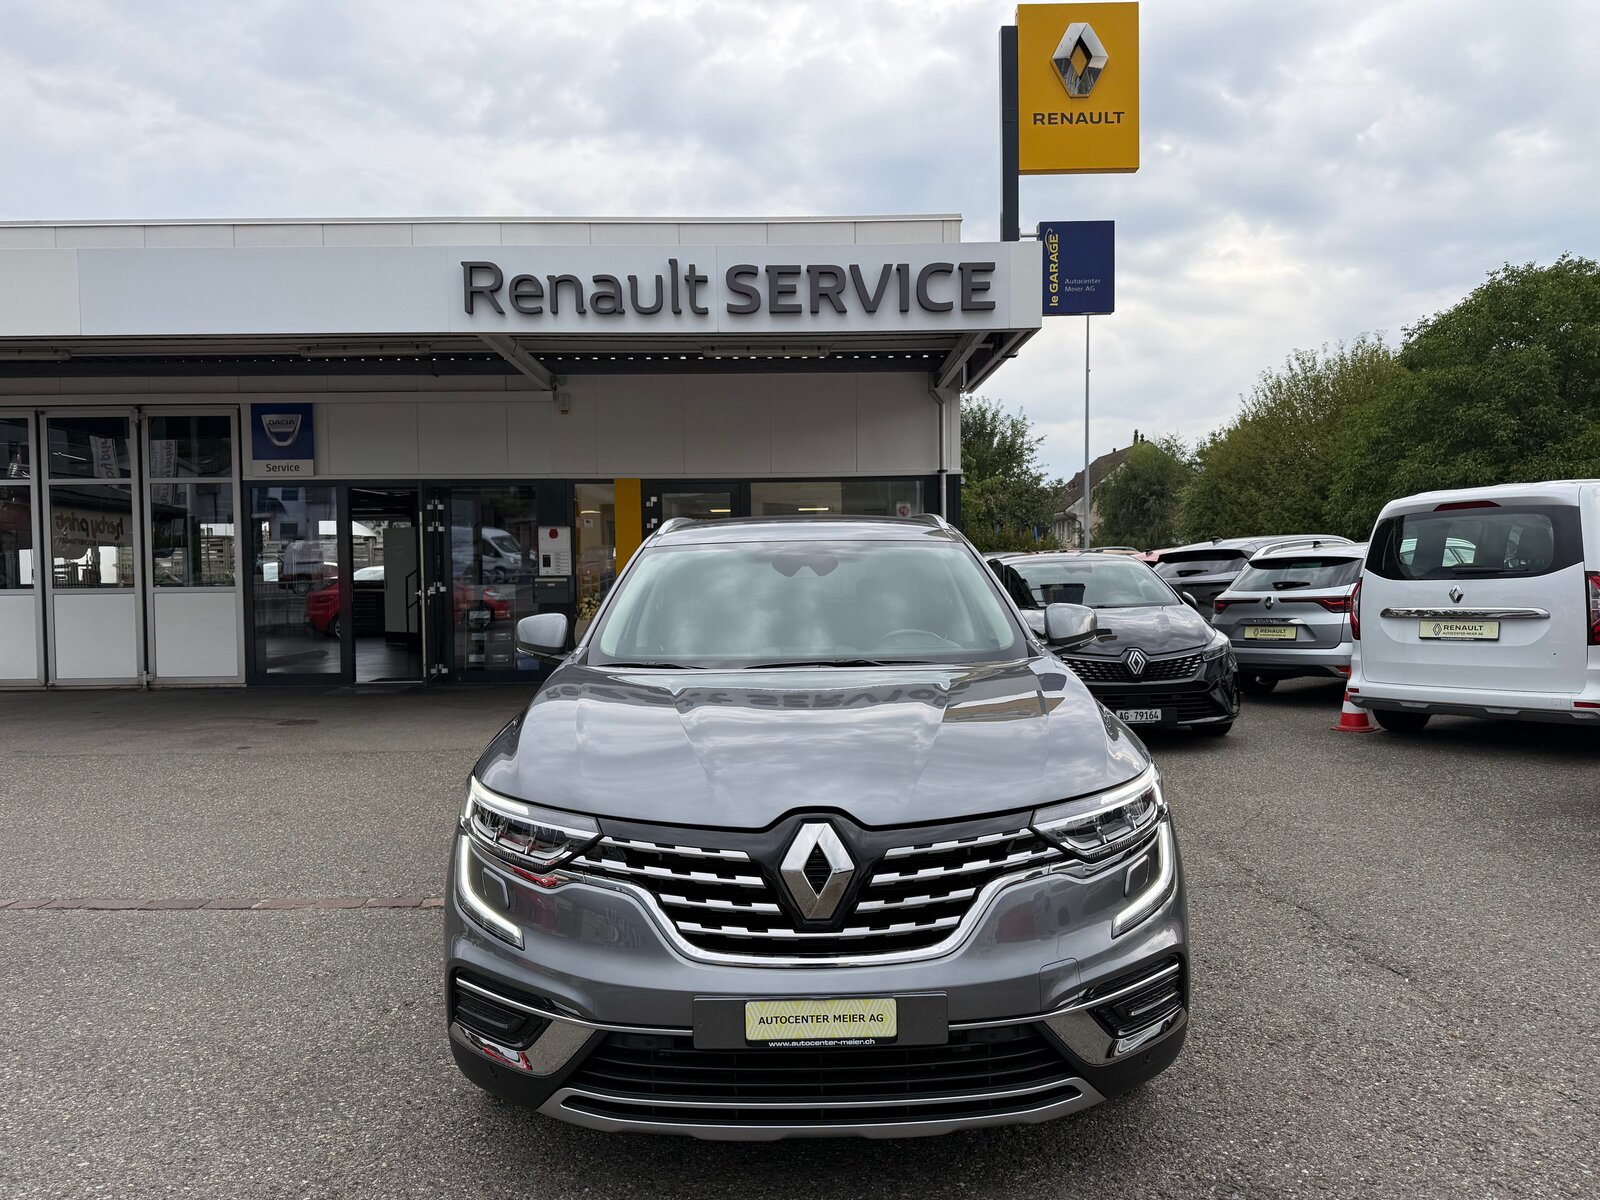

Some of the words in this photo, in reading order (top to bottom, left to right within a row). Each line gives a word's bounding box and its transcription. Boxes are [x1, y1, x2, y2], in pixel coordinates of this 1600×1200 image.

[1032, 111, 1125, 125] RENAULT
[1049, 233, 1059, 293] GARAGE
[461, 258, 708, 316] Renault
[724, 261, 996, 314] SERVICE
[1049, 295, 1059, 307] le
[265, 463, 300, 473] Service
[1133, 711, 1159, 720] 79164
[758, 1013, 830, 1026] AUTOCENTER
[832, 1013, 866, 1024] MEIER
[868, 1013, 885, 1023] AG
[768, 1038, 876, 1048] www.autocenter-meier.ch
